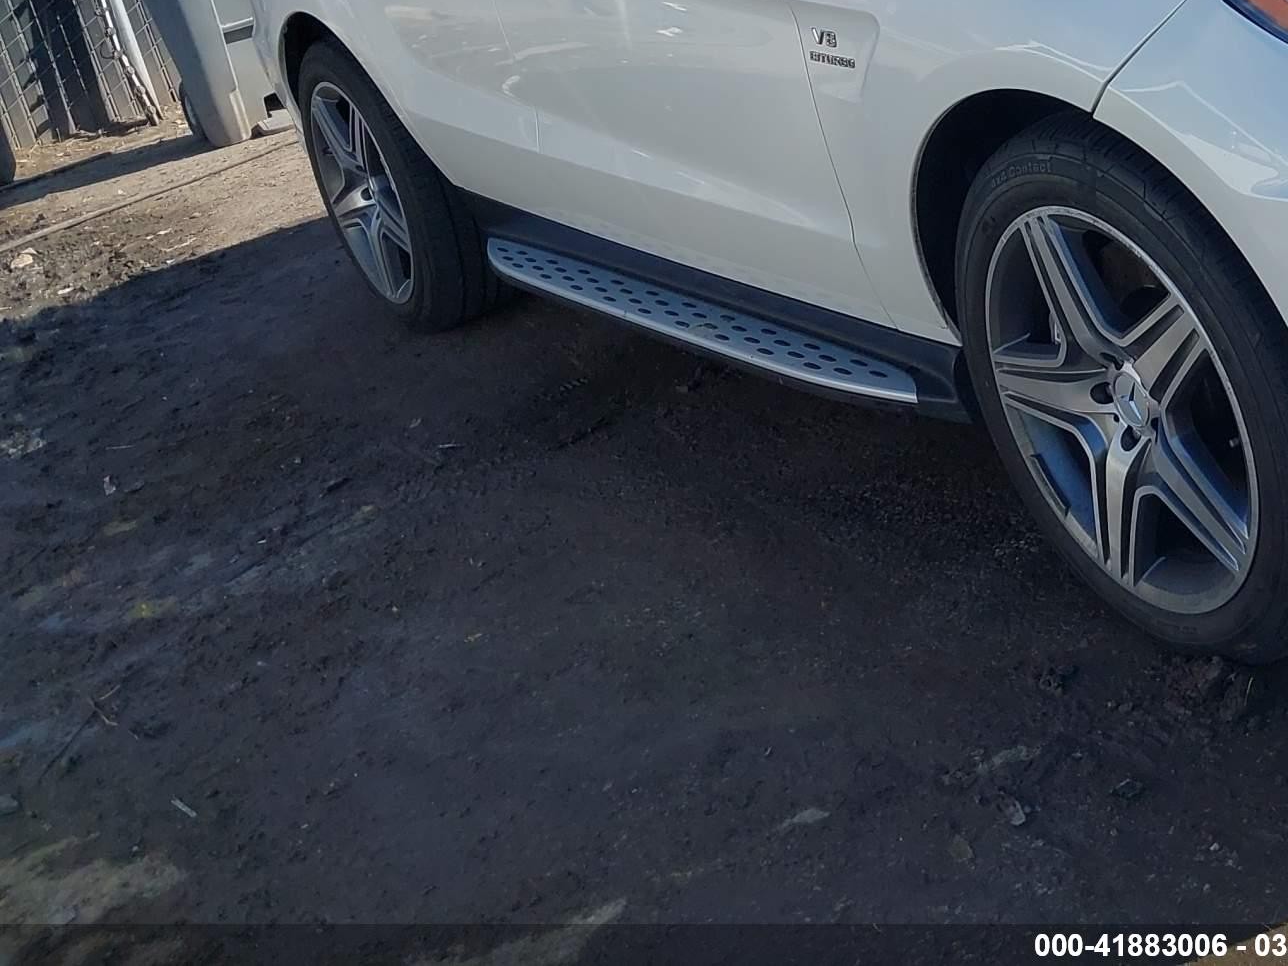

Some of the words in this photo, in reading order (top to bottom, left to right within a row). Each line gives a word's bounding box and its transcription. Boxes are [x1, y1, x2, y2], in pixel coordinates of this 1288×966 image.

[811, 27, 837, 48] V8
[809, 50, 856, 69] BITURBO
[1008, 161, 1051, 177] Contact
